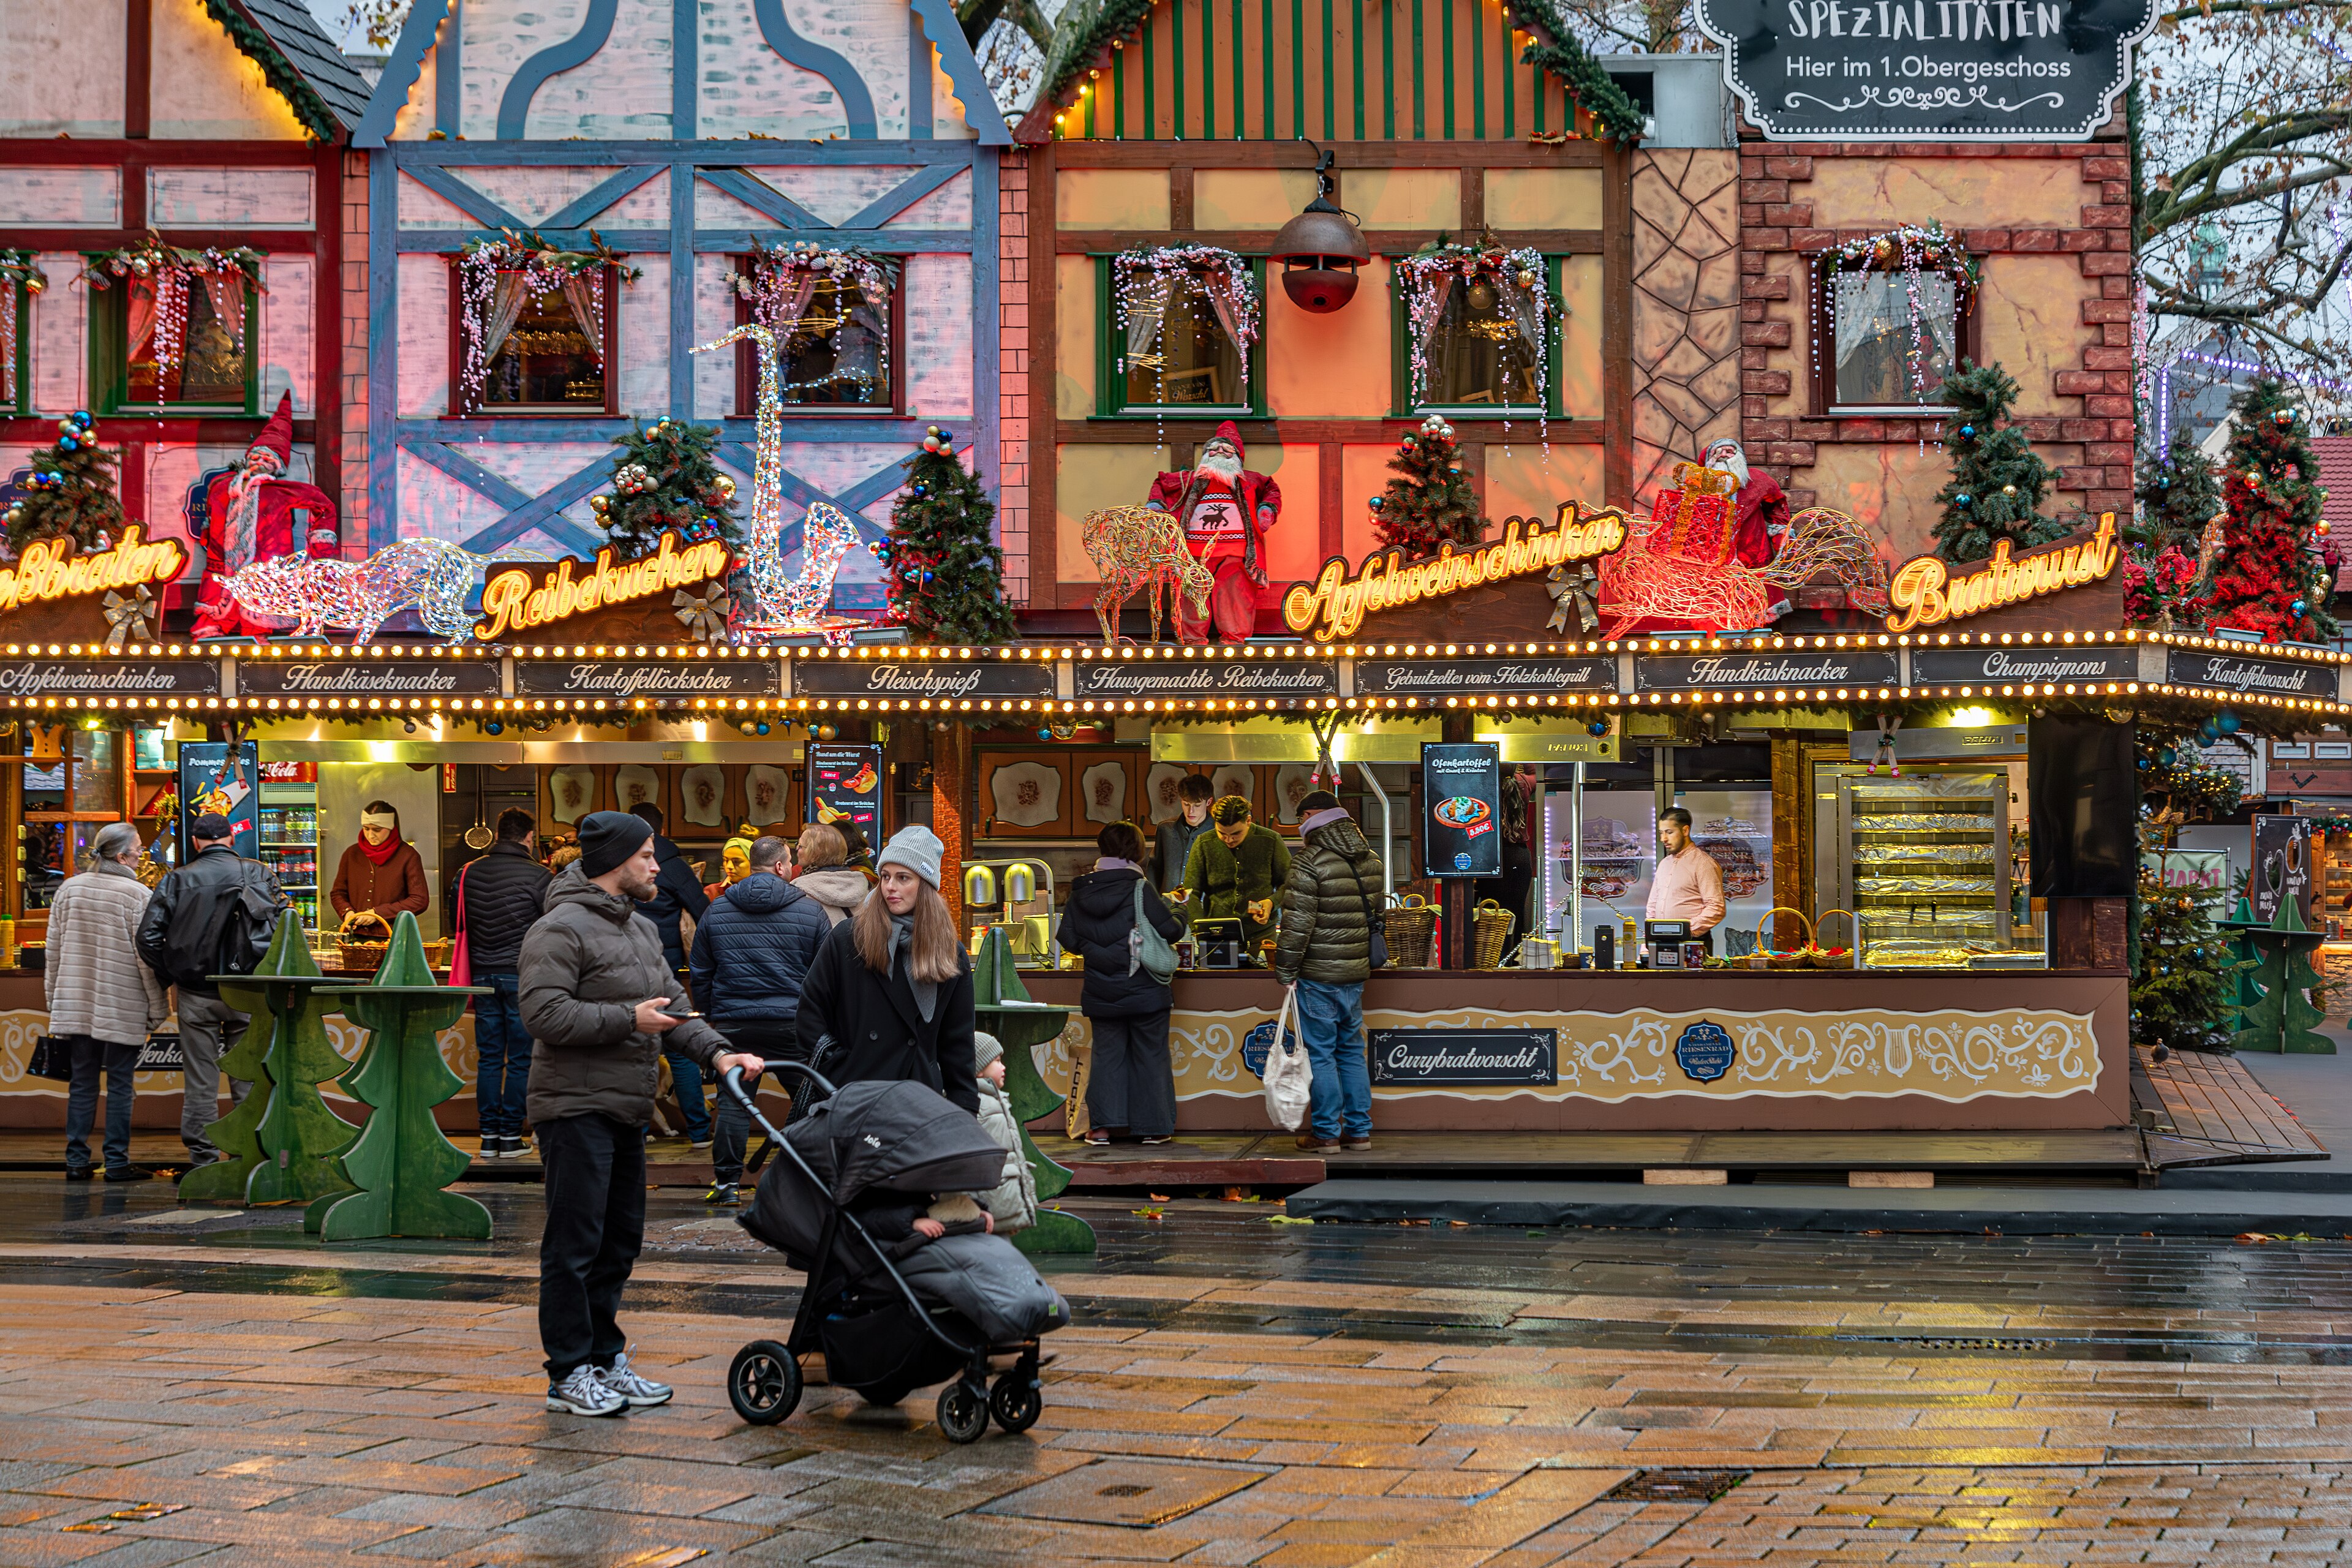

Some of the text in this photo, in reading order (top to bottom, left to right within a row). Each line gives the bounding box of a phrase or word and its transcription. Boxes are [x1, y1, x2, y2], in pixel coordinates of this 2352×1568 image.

[1788, 0, 2061, 42] SPEZIALITÄTEN
[1787, 55, 2071, 83] Hier im 1.Obergeschoss
[474, 530, 729, 641] Reibekuchen
[1286, 504, 1628, 641] Apfelweinschinken
[1885, 511, 2119, 633] Bratwurst
[0, 662, 177, 696] Apfelweinschinken
[281, 663, 457, 692] Handkäseknacker
[564, 663, 733, 696] Kartoffellöckscher
[867, 664, 982, 698] Fleischspieß
[1091, 665, 1325, 696] Hausgemachte Reibekuchen
[1384, 665, 1591, 691] Gebrutzeltes vom Holzkohlegrill
[1686, 657, 1849, 685] Handkäsknacker
[1983, 650, 2107, 684] Champignons
[2203, 658, 2307, 691] Kartoffelworscht
[188, 758, 225, 766] Pommes
[1431, 758, 1491, 768] Ofenkartoffel
[1388, 1044, 1537, 1075] Currybratworscht
